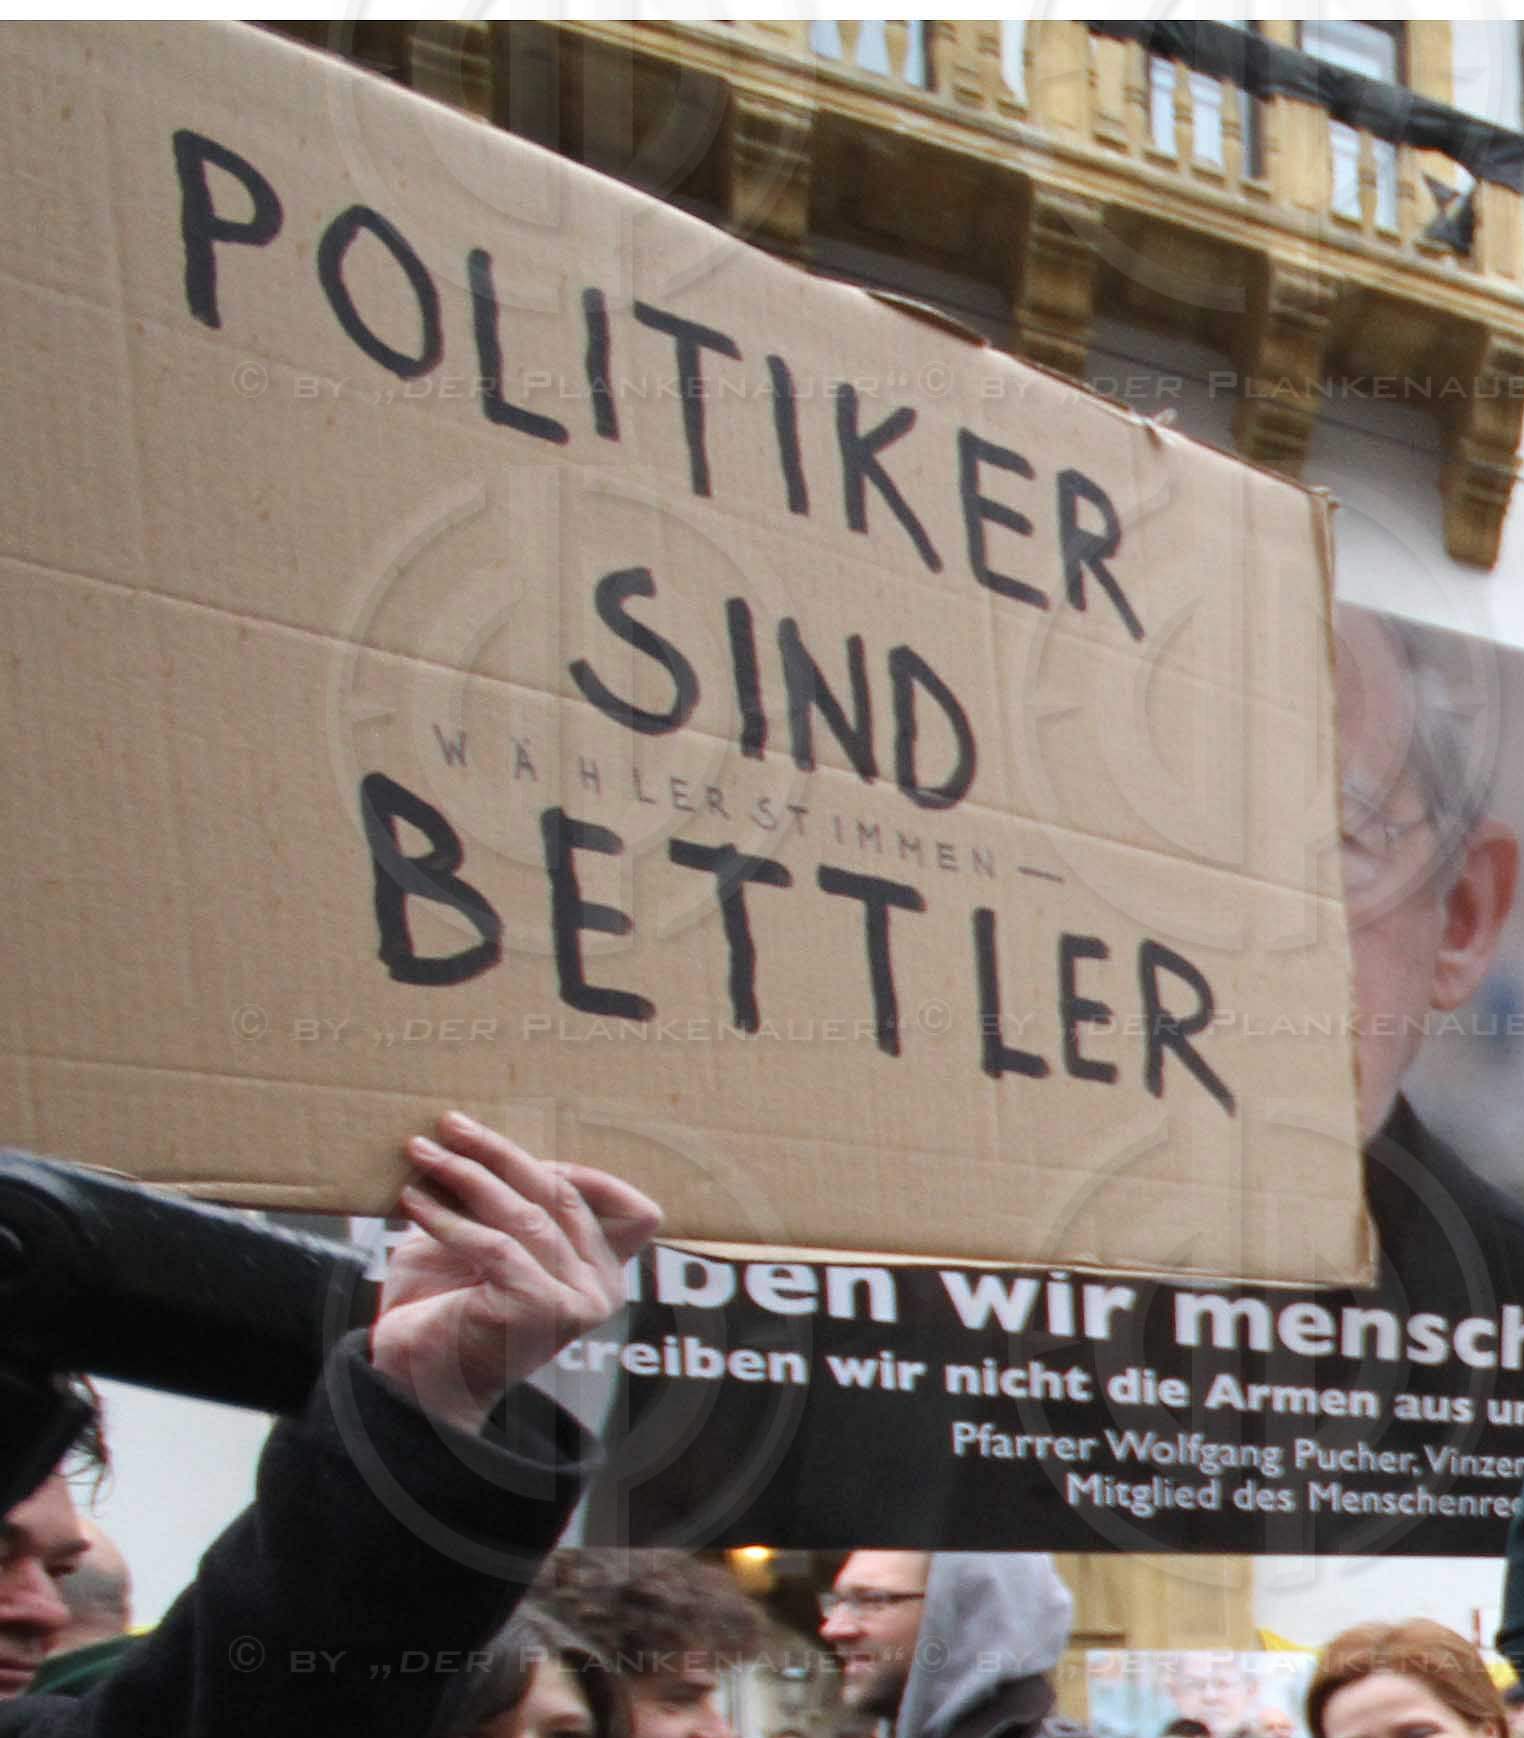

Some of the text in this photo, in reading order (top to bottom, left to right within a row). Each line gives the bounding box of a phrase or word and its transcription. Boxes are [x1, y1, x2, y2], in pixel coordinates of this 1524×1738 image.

[173, 130, 1142, 641] POLITIKER
[568, 565, 977, 810] SIND
[358, 771, 1237, 1117] BETTLER
[939, 1270, 1136, 1341] wir
[825, 1350, 926, 1392] wir
[944, 1360, 1093, 1401] nicht
[1107, 1367, 1190, 1408] die
[1205, 1372, 1379, 1421] Armen
[1393, 1394, 1474, 1423] aus
[950, 1420, 1097, 1463] Pfarrer
[1105, 1427, 1283, 1478] Wolfgang
[1065, 1471, 1221, 1519] Mitglied
[1231, 1478, 1296, 1513] des
